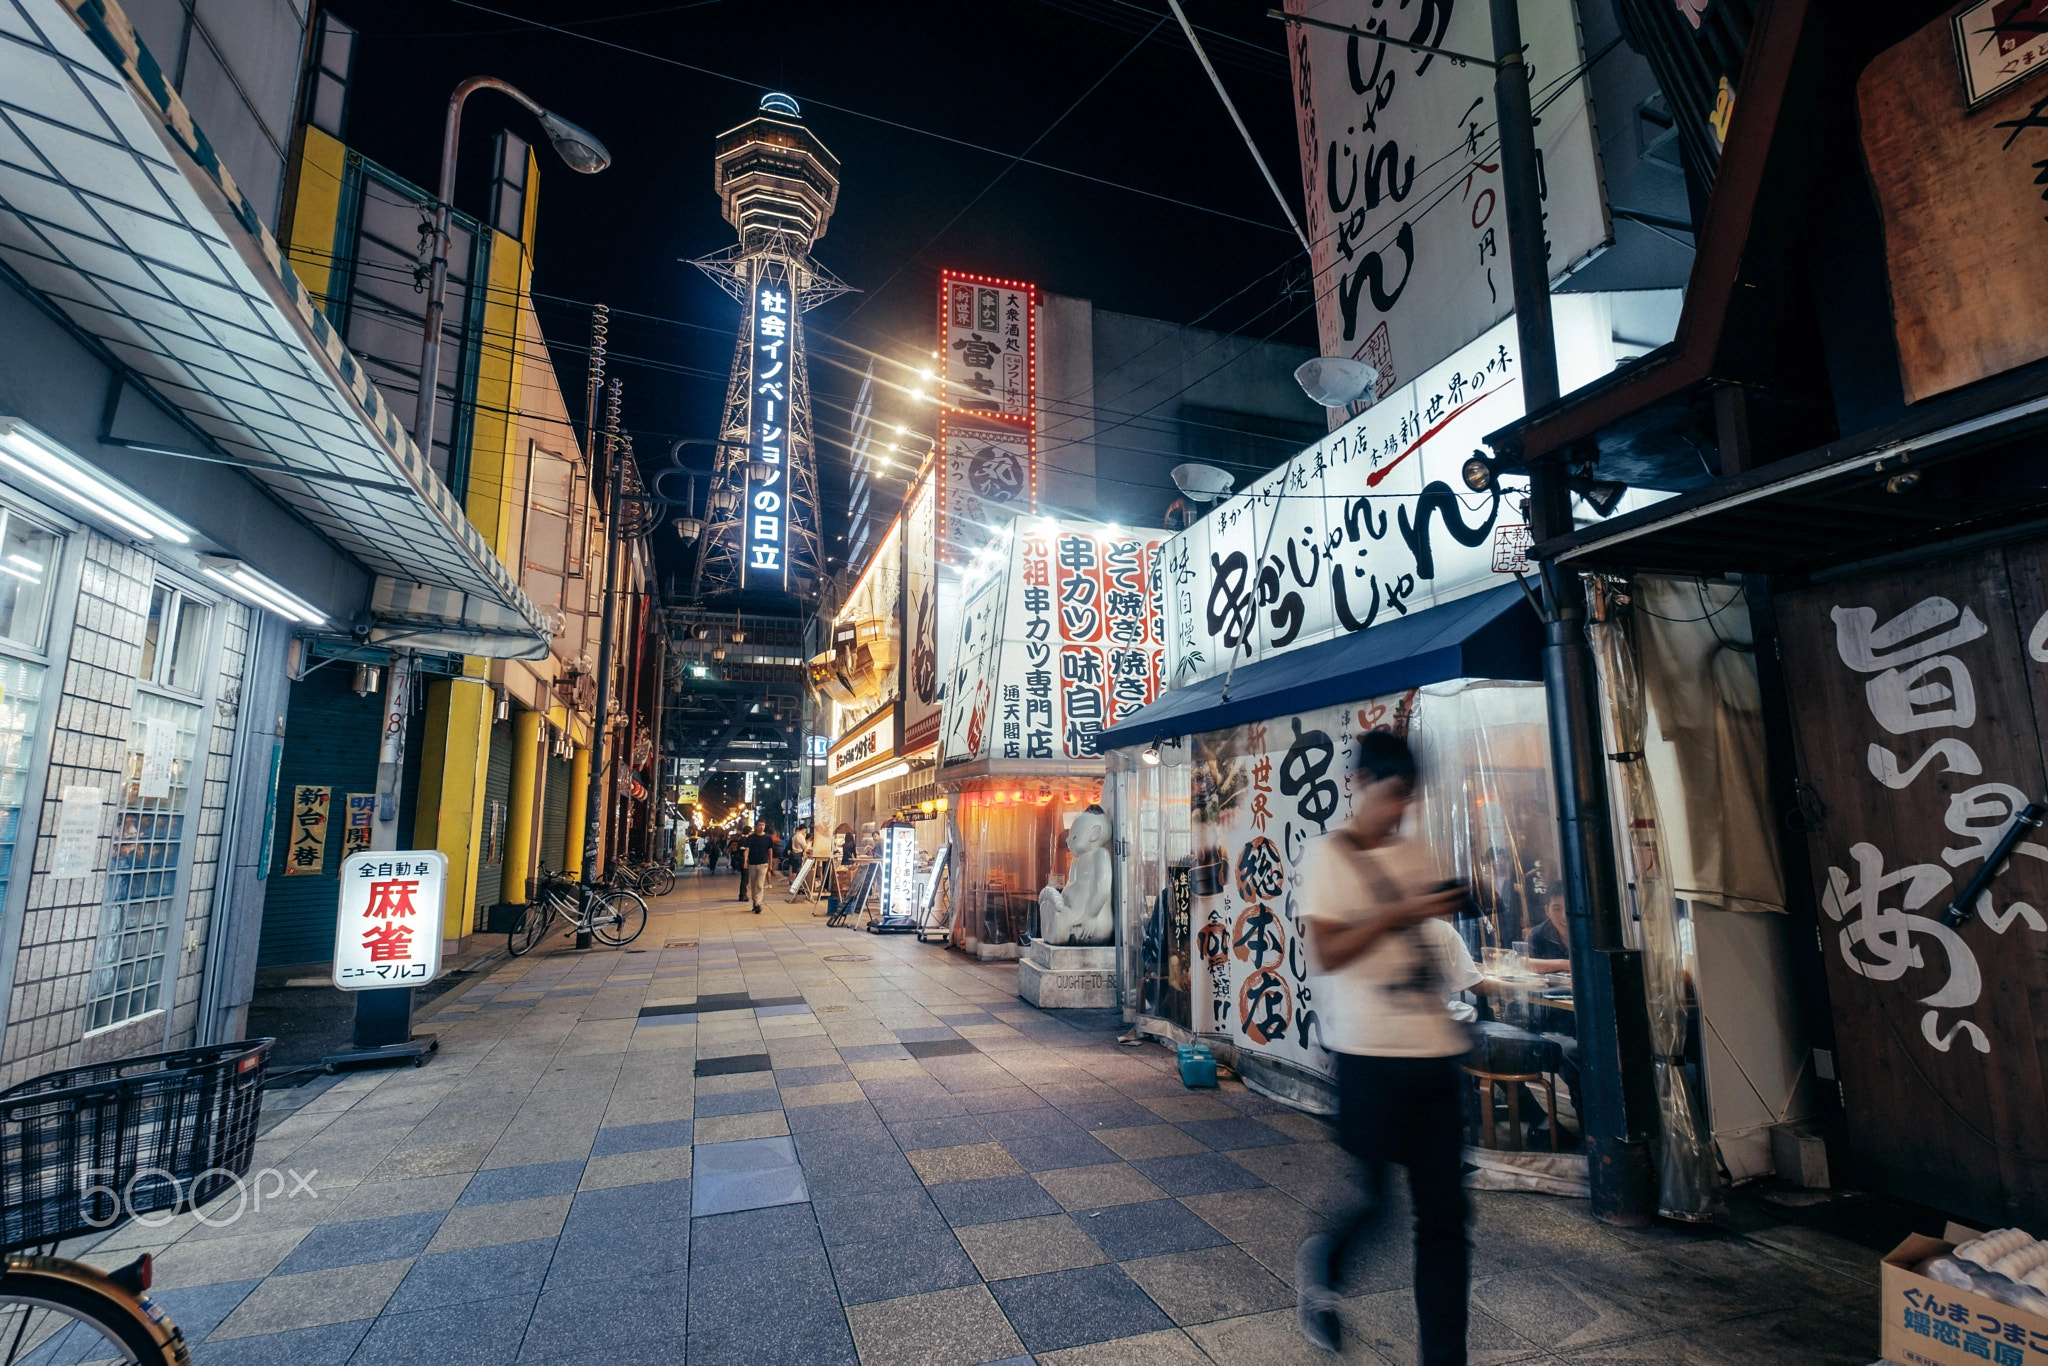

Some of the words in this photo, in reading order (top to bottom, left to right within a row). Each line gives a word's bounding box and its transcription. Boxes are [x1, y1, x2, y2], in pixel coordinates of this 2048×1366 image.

[955, 290, 971, 325] 新世界
[981, 294, 996, 328] 串かつ
[1005, 293, 1020, 353] 大衆酒処
[1059, 536, 1098, 640] 串カツ
[1494, 528, 1513, 571] 本店
[1107, 540, 1144, 643] どて焼き
[1169, 537, 1197, 648] 味自慢
[1022, 531, 1054, 759] 元祖串カツ専門店
[1003, 684, 1021, 759] 通天閣店
[1062, 652, 1105, 757] 味自慢
[1249, 720, 1274, 833] 新世界
[292, 787, 330, 867] 新台入替
[358, 861, 431, 878] 全自動卓
[362, 878, 420, 963] 麻雀
[1233, 837, 1288, 1043] 総本店
[342, 963, 427, 980] ニューマルコ
